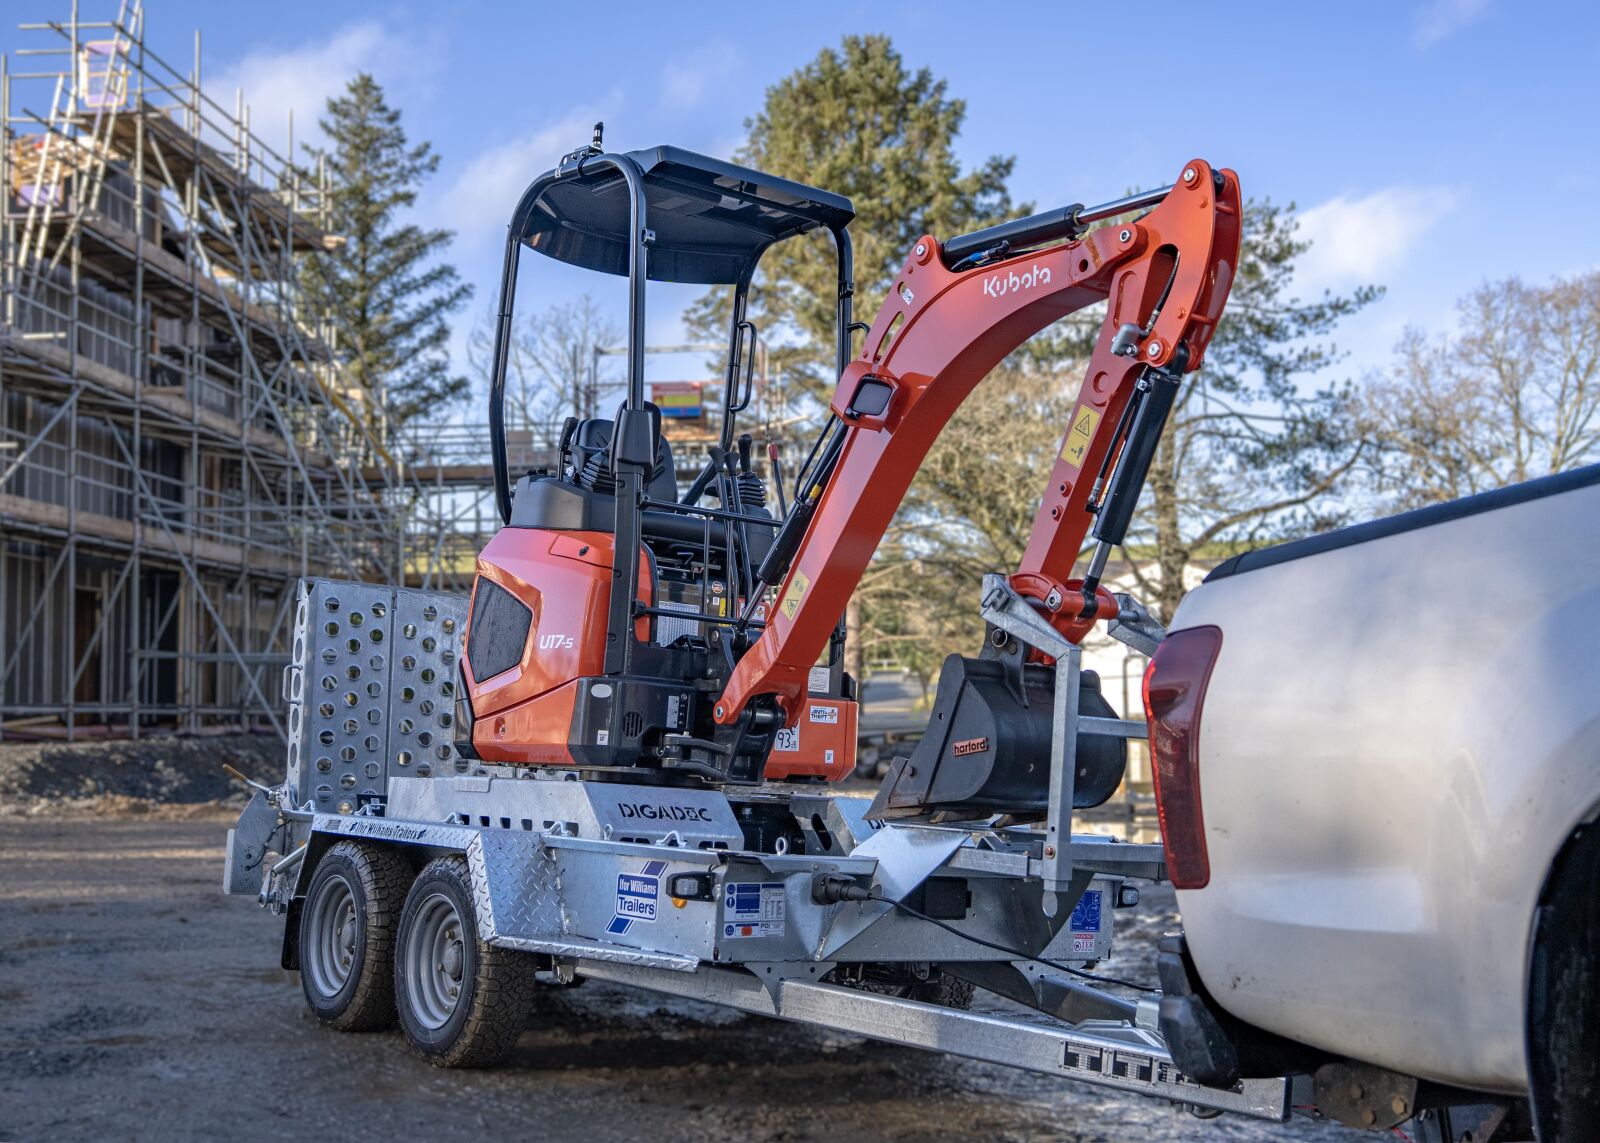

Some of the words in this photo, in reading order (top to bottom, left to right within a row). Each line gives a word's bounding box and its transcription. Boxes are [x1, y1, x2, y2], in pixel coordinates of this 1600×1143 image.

[983, 264, 1051, 298] Kubota
[539, 634, 574, 649] U17-5
[777, 731, 791, 748] 93
[953, 739, 986, 755] harford
[618, 803, 712, 822] DIGADOC
[367, 822, 394, 837] Williams
[393, 825, 418, 840] Trailers
[619, 878, 630, 891] Ifor
[630, 879, 657, 895] Williams
[618, 896, 655, 915] Trailers
